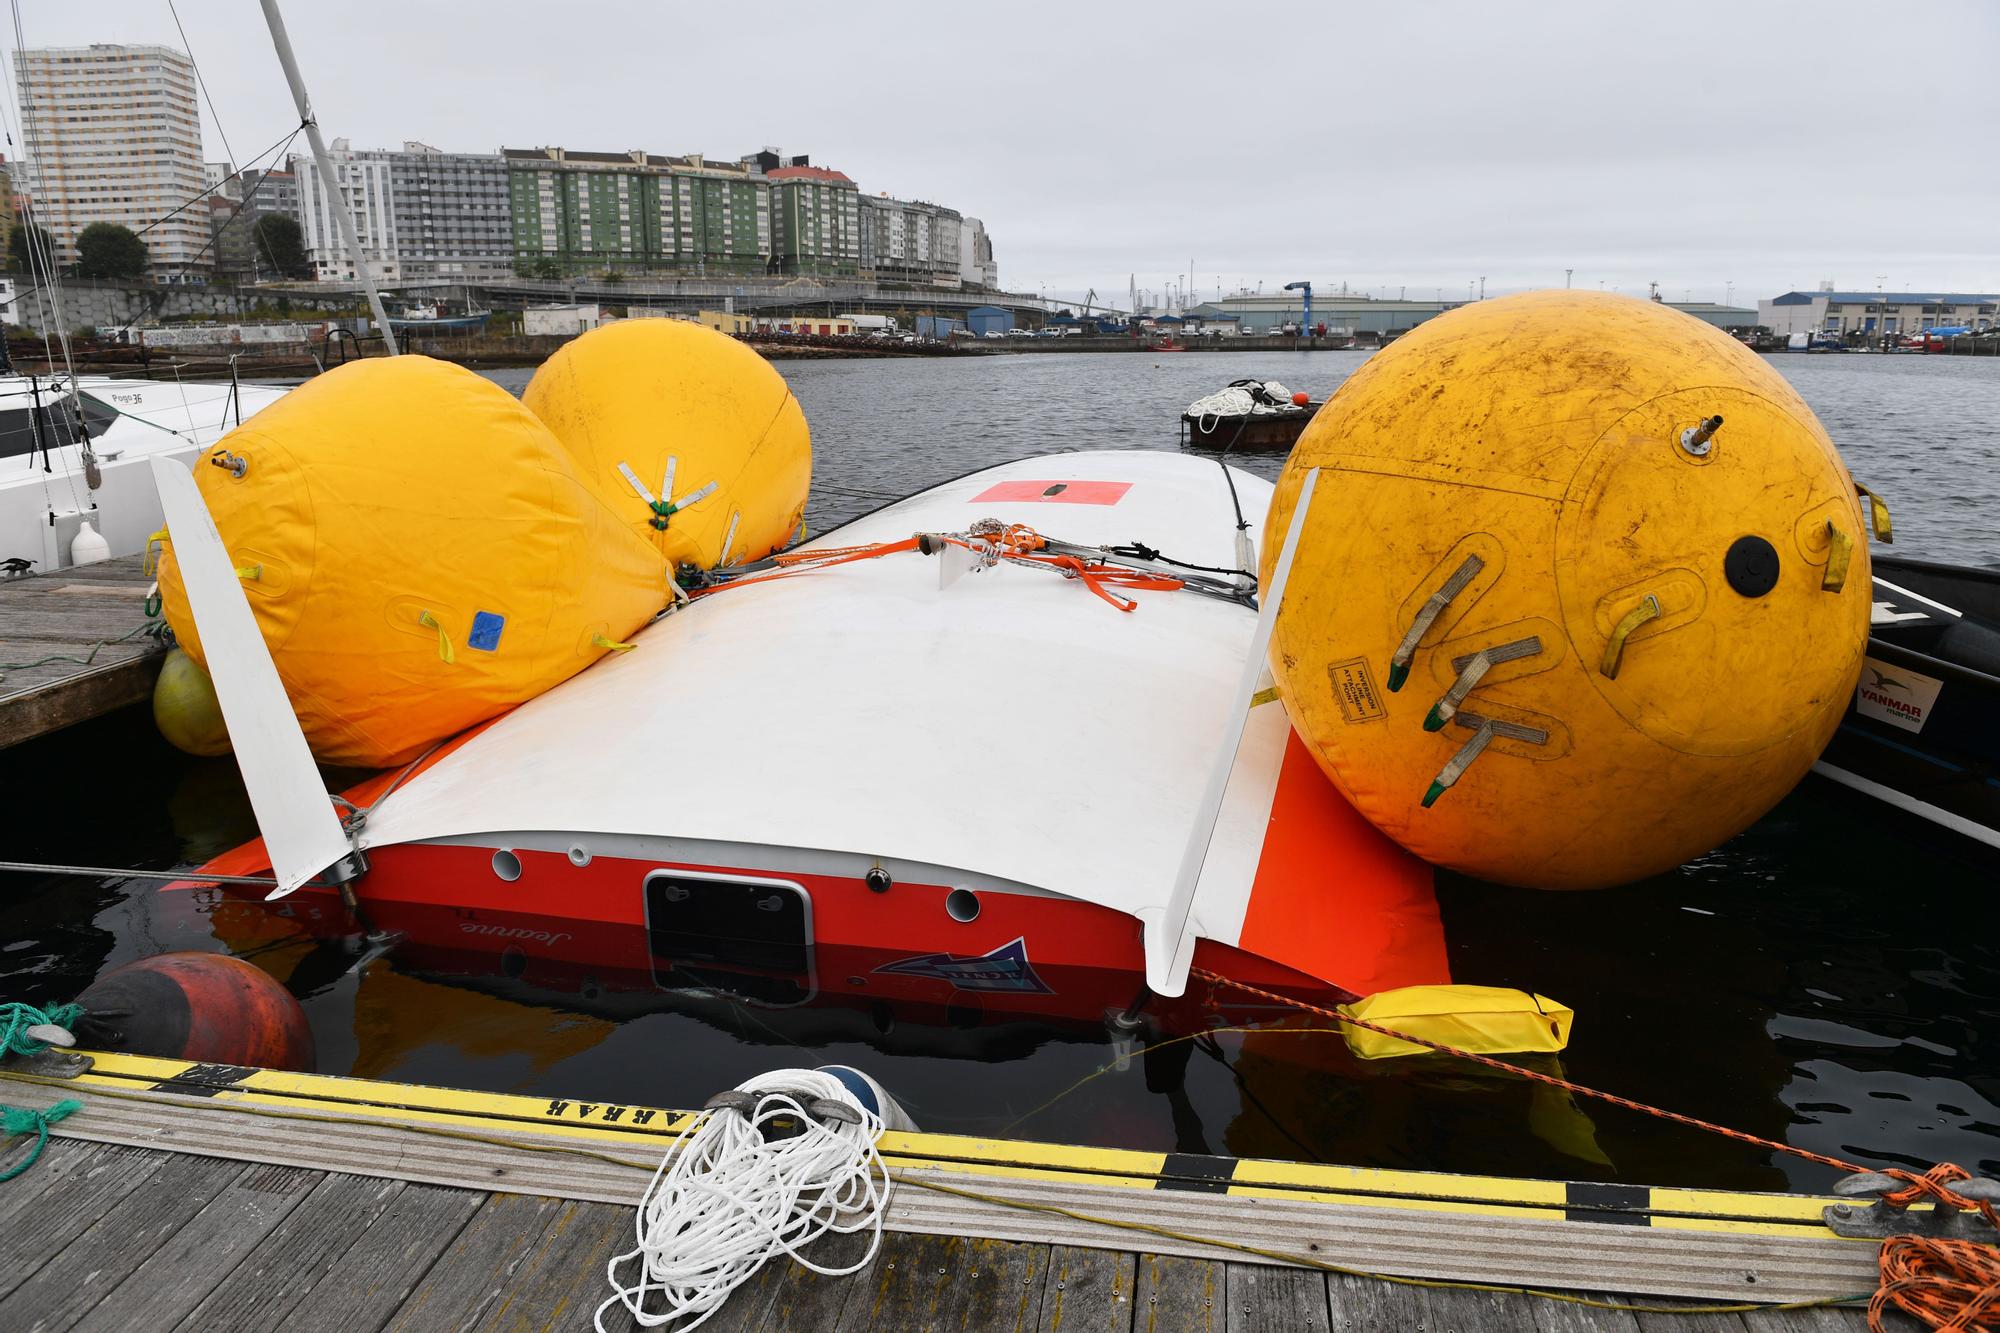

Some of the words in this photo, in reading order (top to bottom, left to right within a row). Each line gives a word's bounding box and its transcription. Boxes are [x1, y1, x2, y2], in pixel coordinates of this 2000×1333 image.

[1343, 683, 1354, 704] POINT
[1344, 669, 1365, 716] ATTACHMENT
[1355, 683, 1365, 699] LINE
[1358, 670, 1376, 709] INVERSION
[1861, 688, 1921, 717] YANMAR
[1886, 708, 1921, 723] marine
[459, 922, 572, 946] Jeanne
